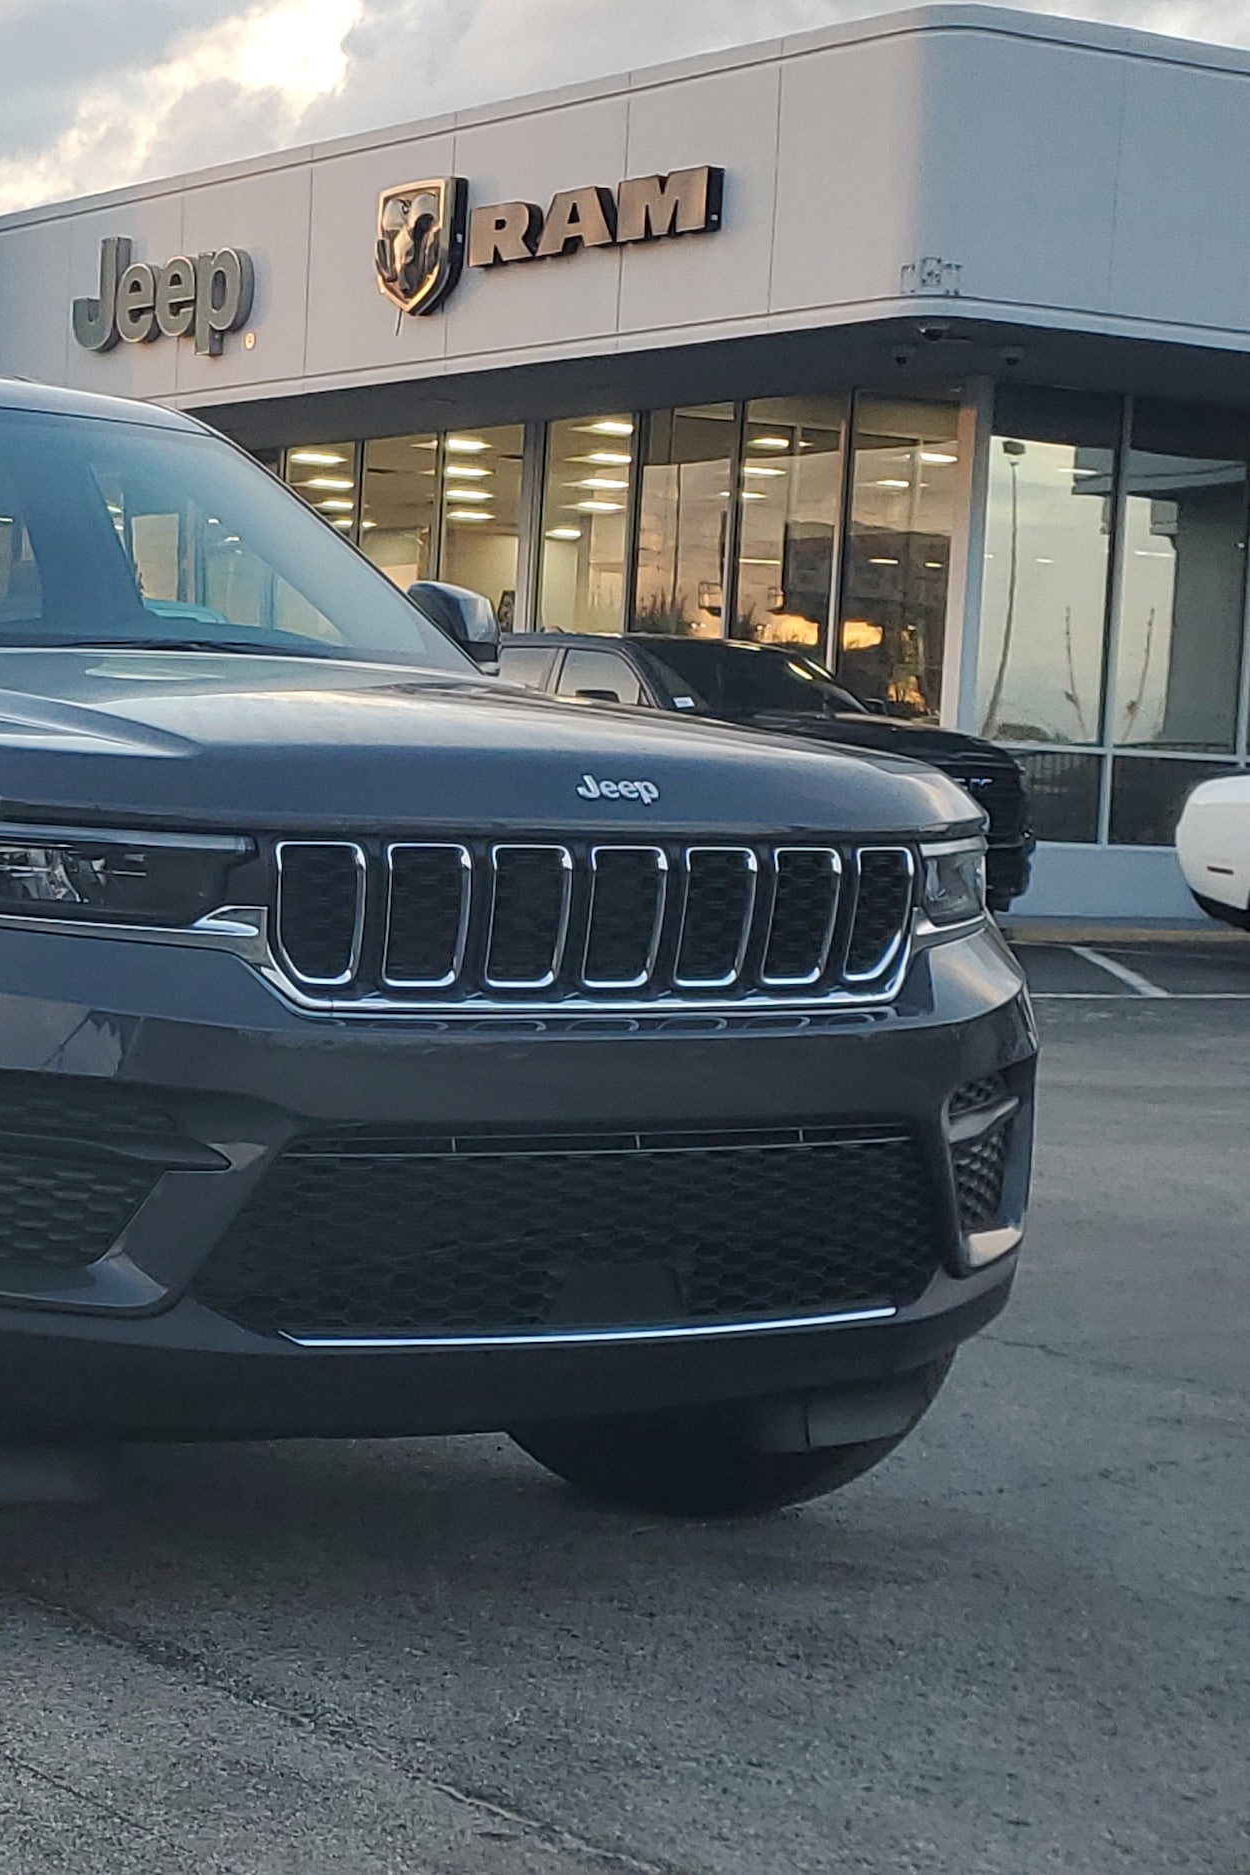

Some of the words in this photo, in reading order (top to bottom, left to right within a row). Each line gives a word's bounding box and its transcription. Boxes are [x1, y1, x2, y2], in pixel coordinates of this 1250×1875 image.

[468, 165, 725, 268] RAM
[72, 235, 254, 356] Jeep
[576, 774, 659, 805] Jeep
